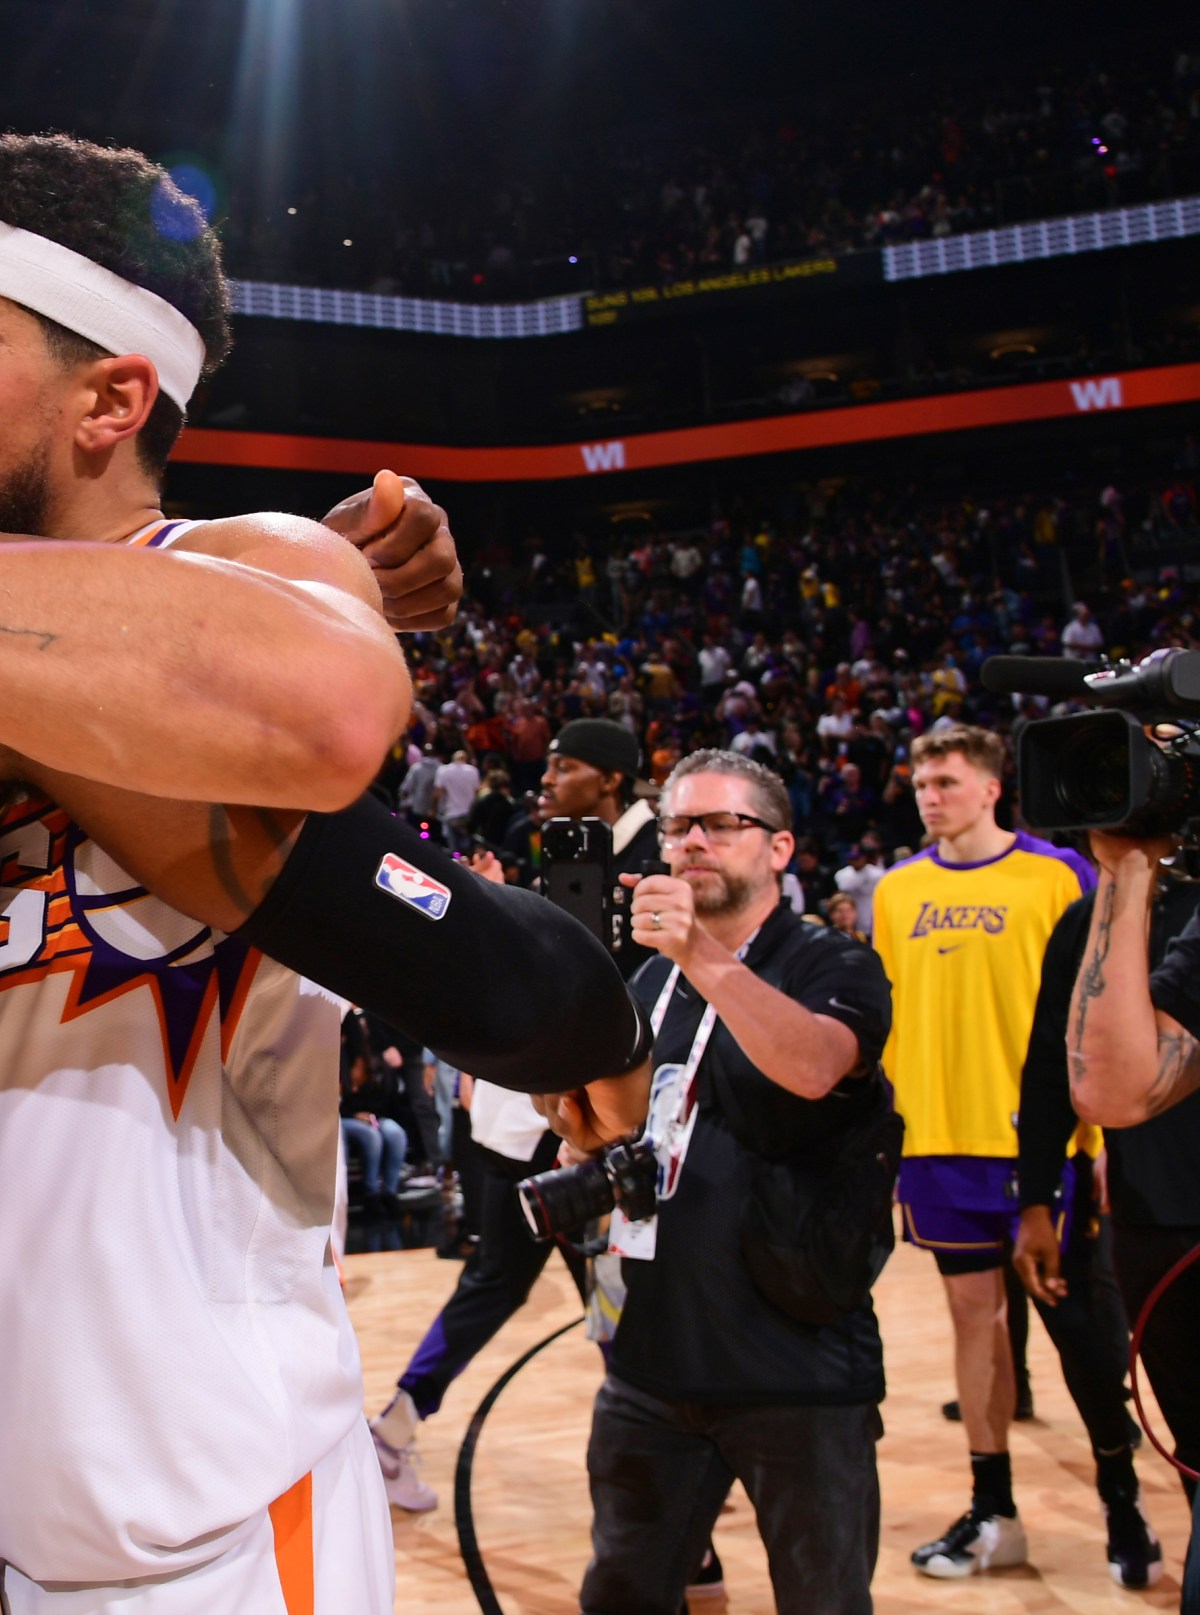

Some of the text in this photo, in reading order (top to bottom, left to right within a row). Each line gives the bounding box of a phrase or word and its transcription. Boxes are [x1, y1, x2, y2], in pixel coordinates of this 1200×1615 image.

[663, 280, 696, 299] LOS
[698, 268, 770, 292] ANGELES
[774, 258, 838, 281] LAKERS
[1070, 377, 1122, 411] WI
[581, 441, 625, 472] WI
[909, 901, 1007, 940] LAKERS
